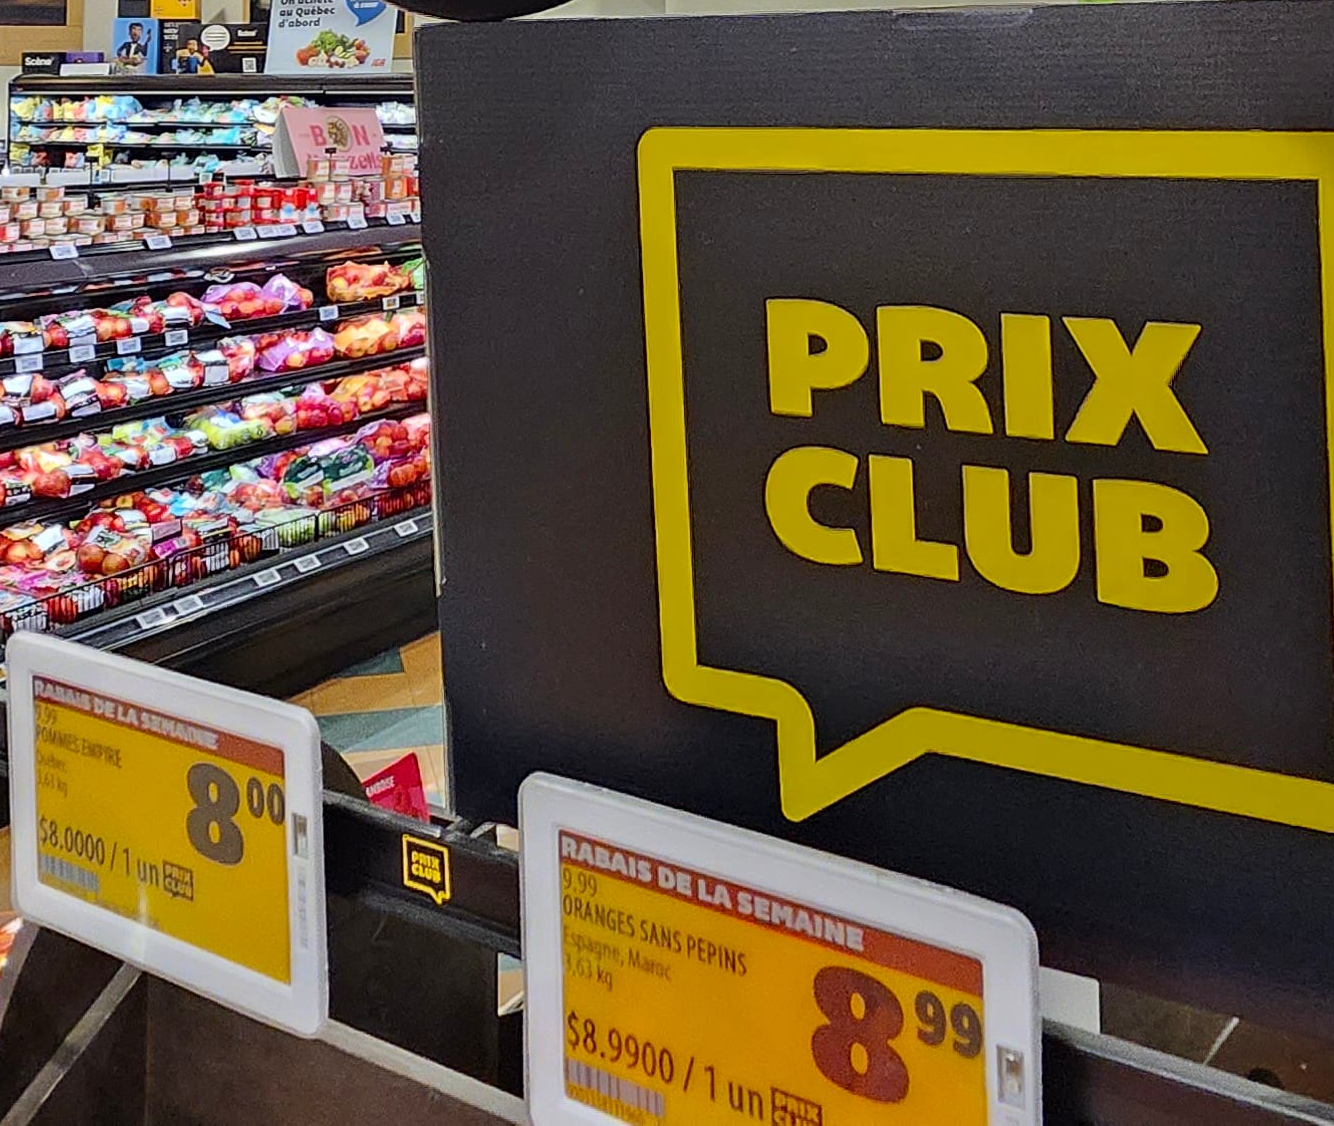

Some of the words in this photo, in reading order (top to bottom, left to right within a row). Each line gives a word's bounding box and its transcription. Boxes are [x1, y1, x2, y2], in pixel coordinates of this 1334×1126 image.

[278, 17, 320, 28] d'abord
[296, 6, 336, 17] Québec
[766, 298, 1208, 455] PRIX
[765, 445, 1219, 614] CLUB
[34, 679, 91, 711] RABAIS
[93, 695, 116, 718] DE
[118, 702, 139, 725] LA
[140, 710, 218, 748] SEMAINE
[39, 814, 105, 866] $8.0000
[110, 841, 117, 872] /
[123, 848, 130, 877] 1
[137, 858, 159, 888] un
[187, 762, 245, 866] 8
[246, 777, 285, 825] 00
[411, 850, 441, 870] PRIX
[411, 863, 442, 884] CLUB
[561, 835, 652, 883] RABAIS
[658, 867, 692, 896] DE
[698, 878, 732, 910] LA
[737, 890, 865, 952] SEMAINE
[563, 867, 597, 898] 9.99
[563, 895, 635, 938] ORANGES
[640, 918, 682, 953] SANS
[687, 936, 748, 976] PEPINS
[596, 965, 613, 992] kg
[567, 1009, 675, 1085] $8.9900
[683, 1056, 694, 1093] /
[704, 1064, 716, 1102] 1
[728, 1081, 765, 1123] un
[811, 966, 909, 1104] 8
[915, 989, 984, 1060] 99
